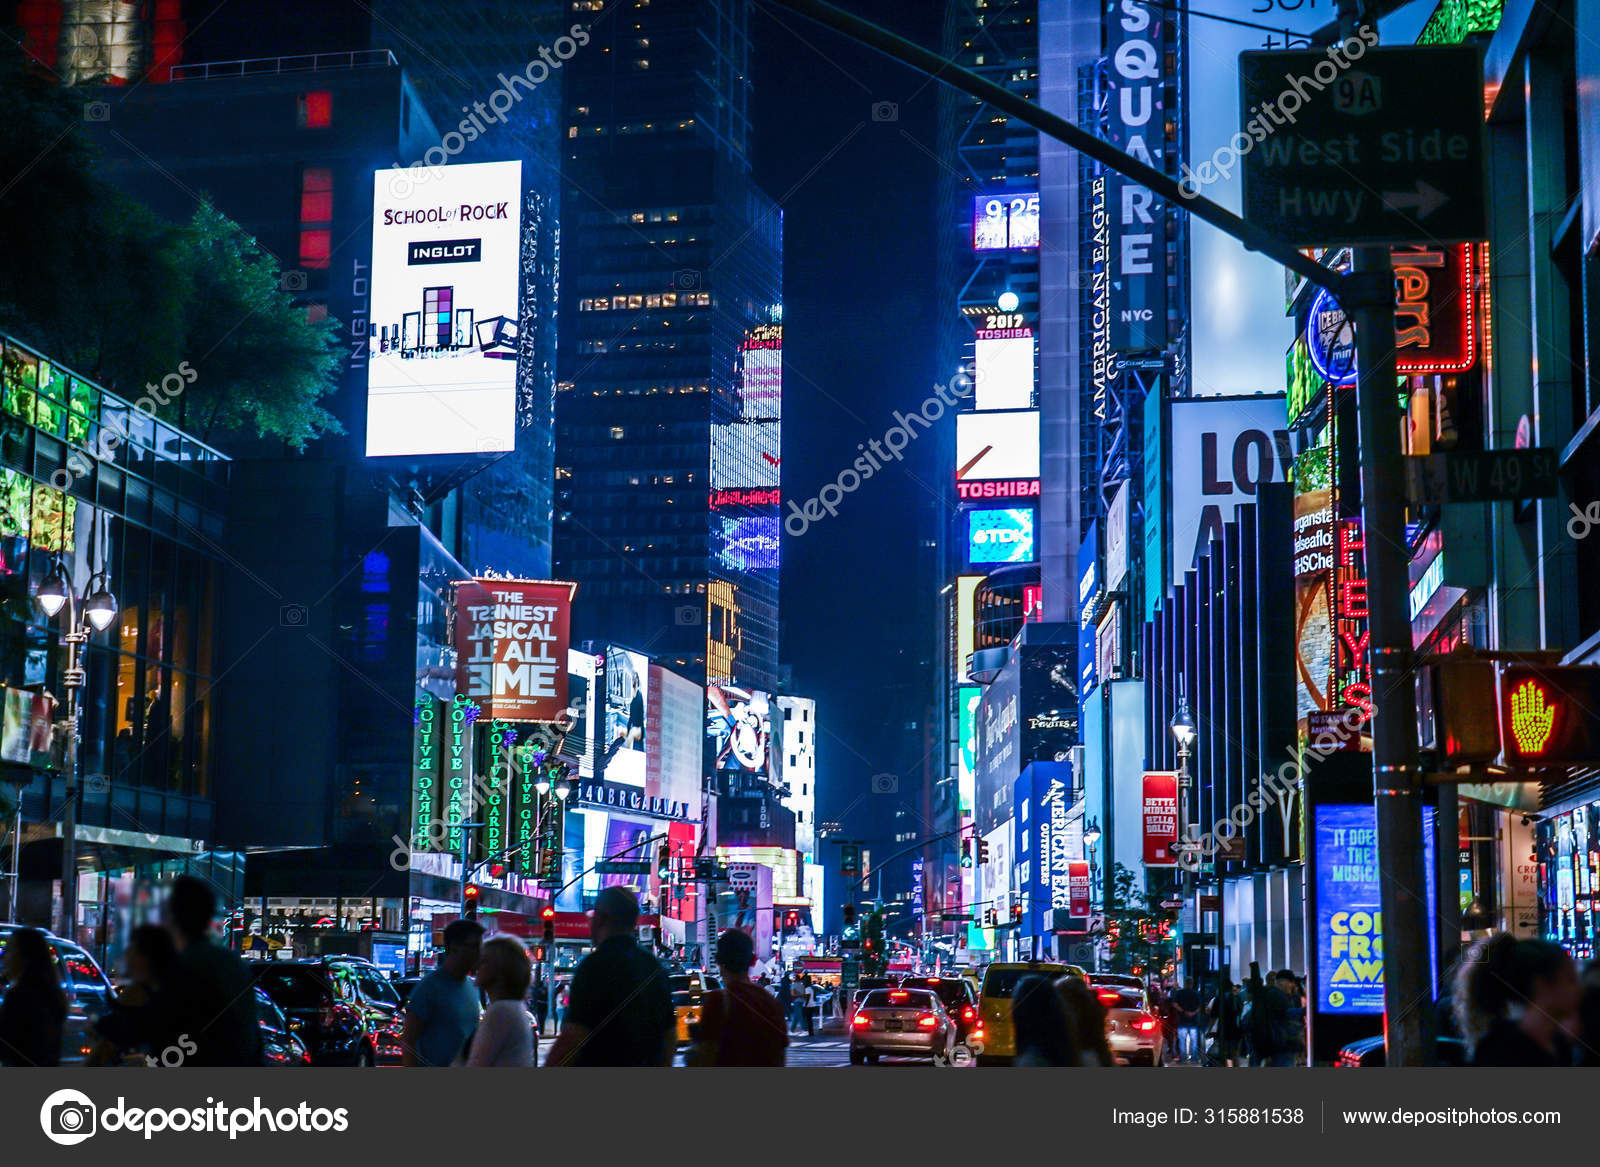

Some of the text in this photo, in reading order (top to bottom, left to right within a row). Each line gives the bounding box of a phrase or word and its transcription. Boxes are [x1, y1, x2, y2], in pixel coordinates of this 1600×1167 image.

[1339, 79, 1376, 108] 9A
[1262, 129, 1468, 167] West Side
[384, 206, 447, 225] SCHOOL
[460, 202, 508, 222] ROCK
[1279, 187, 1364, 223] Hwy
[413, 245, 475, 259] INGLOT
[1093, 177, 1106, 419] AMERICAN EAGLE
[351, 259, 369, 369] INGLOT
[986, 314, 1024, 329] 2017
[1121, 309, 1153, 322] NYC
[1318, 309, 1347, 333] ICEBR
[976, 328, 1033, 340] TOSHIBA
[1455, 458, 1479, 497] W
[1490, 456, 1521, 496] 49
[957, 480, 1040, 499] TOSHIBA
[985, 529, 1029, 544] TDK
[492, 591, 523, 603] THE
[449, 710, 465, 850] OLIVE GARDEN
[522, 753, 533, 804] OLIVE
[488, 733, 503, 861] OLIVE GARDEN
[1145, 798, 1175, 806] BETTE
[1144, 806, 1176, 815] MIDLER
[1051, 778, 1064, 871] AMERICAN
[1334, 829, 1346, 846] IT
[1040, 822, 1050, 886] OUTFITTERS
[1347, 847, 1371, 864] THE
